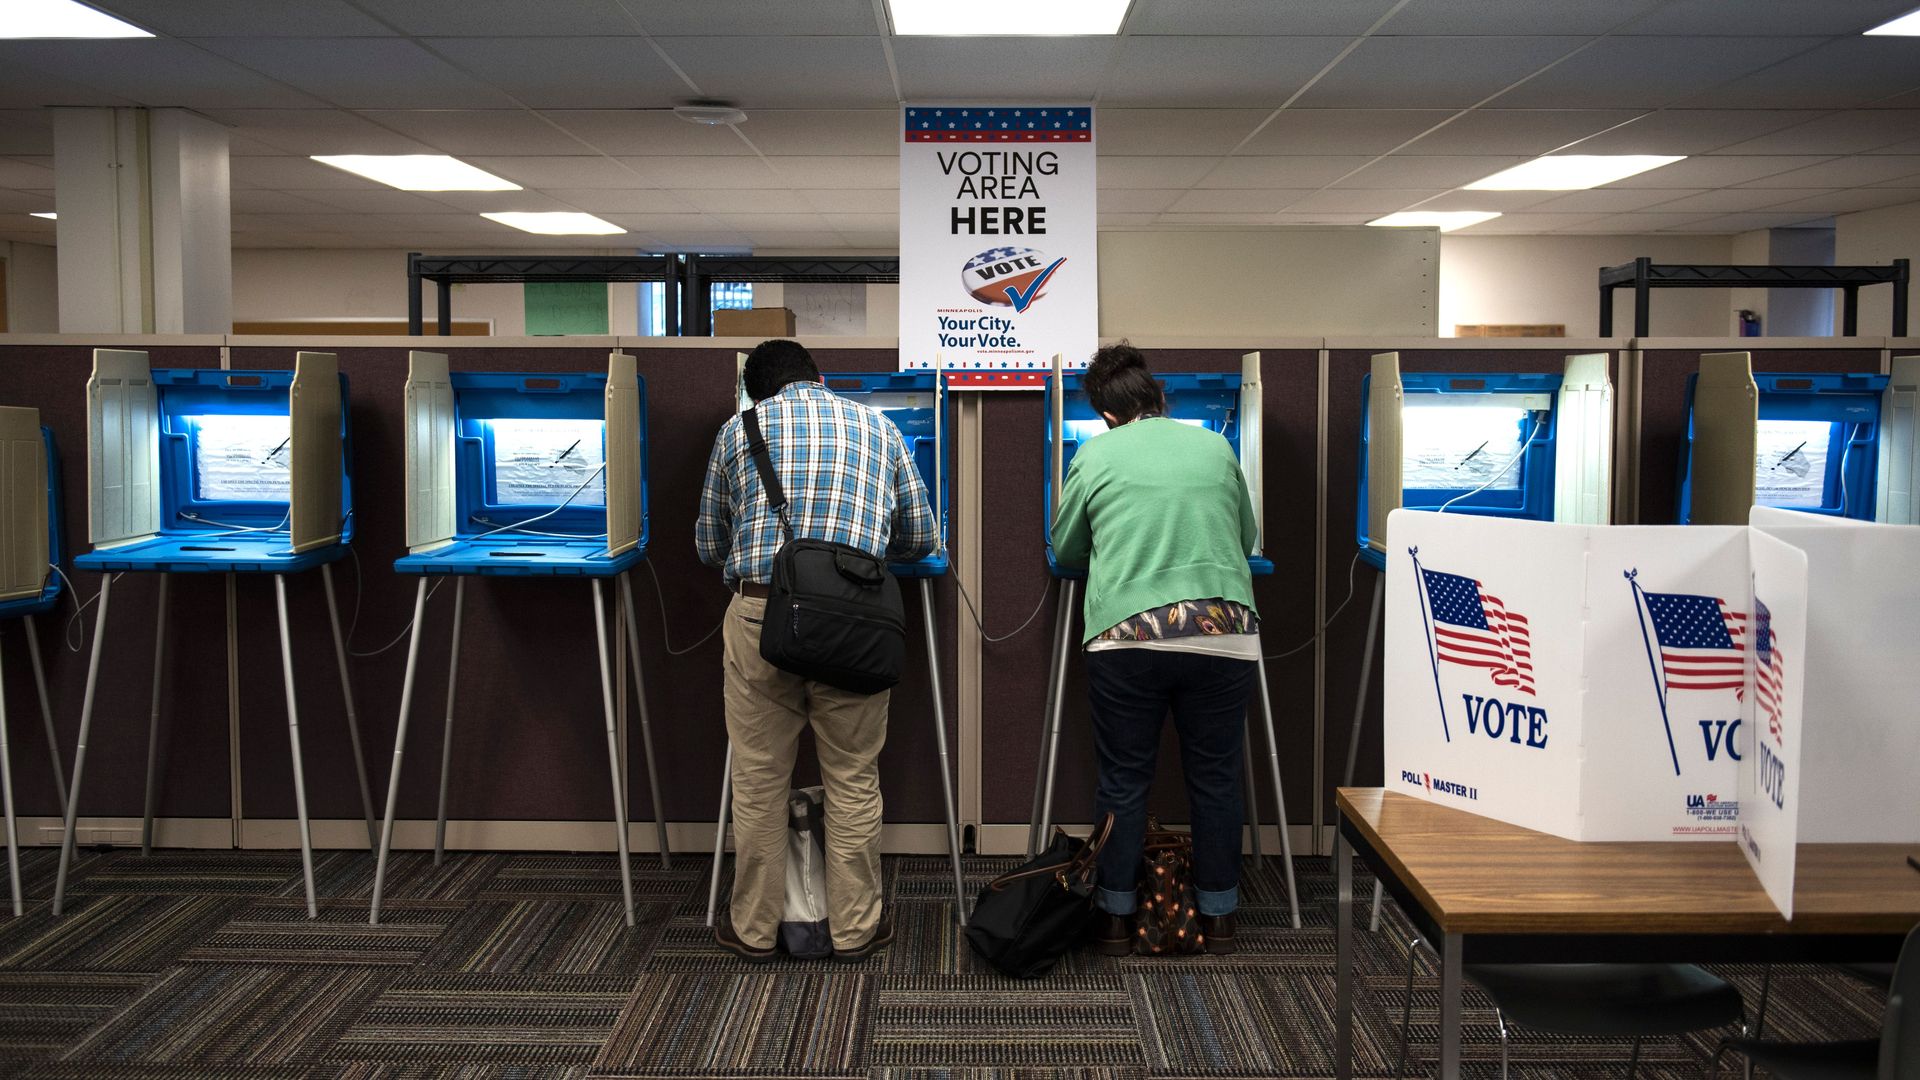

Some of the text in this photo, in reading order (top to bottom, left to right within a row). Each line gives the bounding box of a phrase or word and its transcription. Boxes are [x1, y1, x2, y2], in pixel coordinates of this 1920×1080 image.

[937, 151, 1058, 176] VOTING
[956, 176, 1040, 199] AREA
[951, 207, 1046, 235] HERE
[975, 255, 1041, 281] VOTE
[938, 316, 1015, 334] Your City.
[938, 333, 1021, 348] Your Vote.
[1462, 694, 1549, 750] VOTE
[1698, 719, 1742, 762] VO
[1402, 770, 1478, 800] POLL MASTER II
[1760, 740, 1785, 810] VOTE
[1686, 794, 1705, 808] UA
